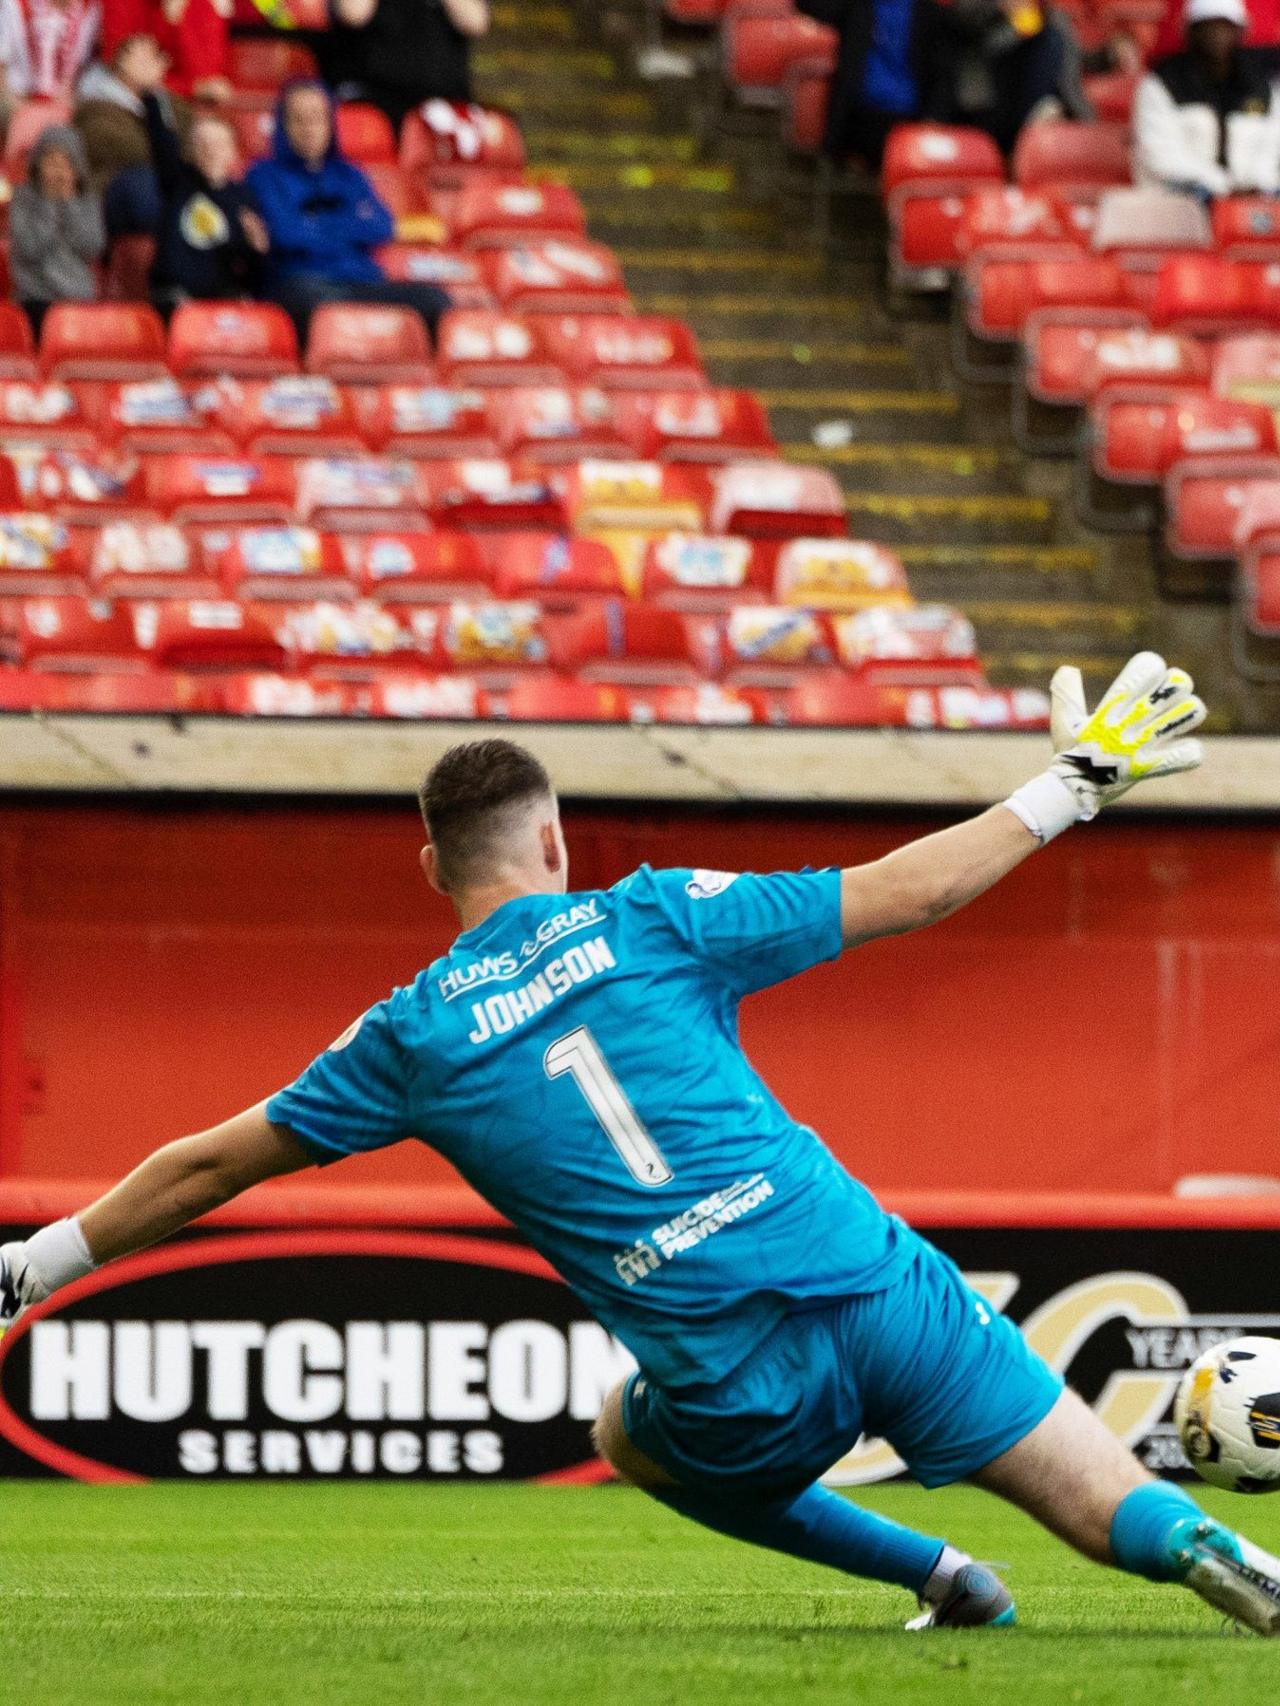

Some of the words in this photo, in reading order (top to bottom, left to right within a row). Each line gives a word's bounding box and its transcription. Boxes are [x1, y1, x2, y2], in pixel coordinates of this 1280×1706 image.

[438, 951, 518, 997] HUWS
[536, 897, 598, 943] GRAY
[469, 936, 616, 1044] JOHNSON
[543, 1024, 674, 1187] 1
[652, 1192, 726, 1245] SUICIDE
[660, 1180, 775, 1260] PREVENTION
[1125, 1327, 1244, 1368] YEAR
[178, 1430, 503, 1474] SERVICES
